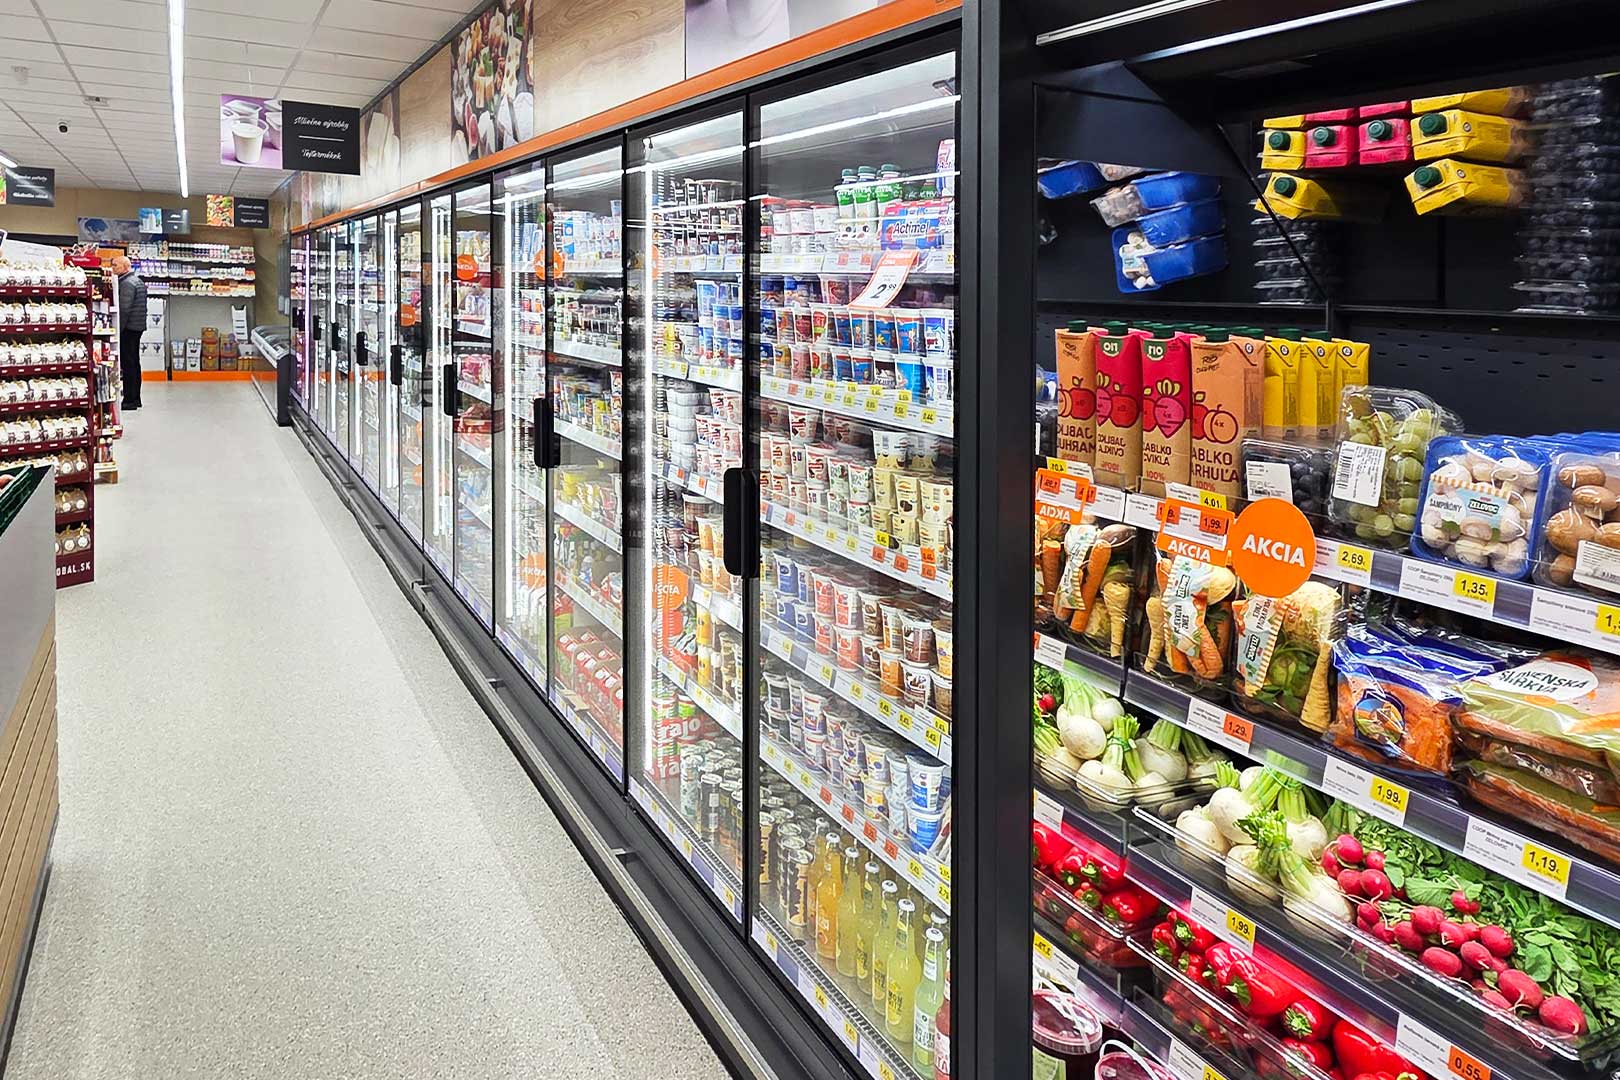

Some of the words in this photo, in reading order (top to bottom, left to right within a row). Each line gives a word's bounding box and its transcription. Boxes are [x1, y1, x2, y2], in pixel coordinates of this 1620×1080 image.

[893, 221, 929, 234] Actimel
[1469, 501, 1498, 513] ZELOVOC
[1167, 540, 1211, 562] AKCIA
[1242, 533, 1305, 568] AKCIA
